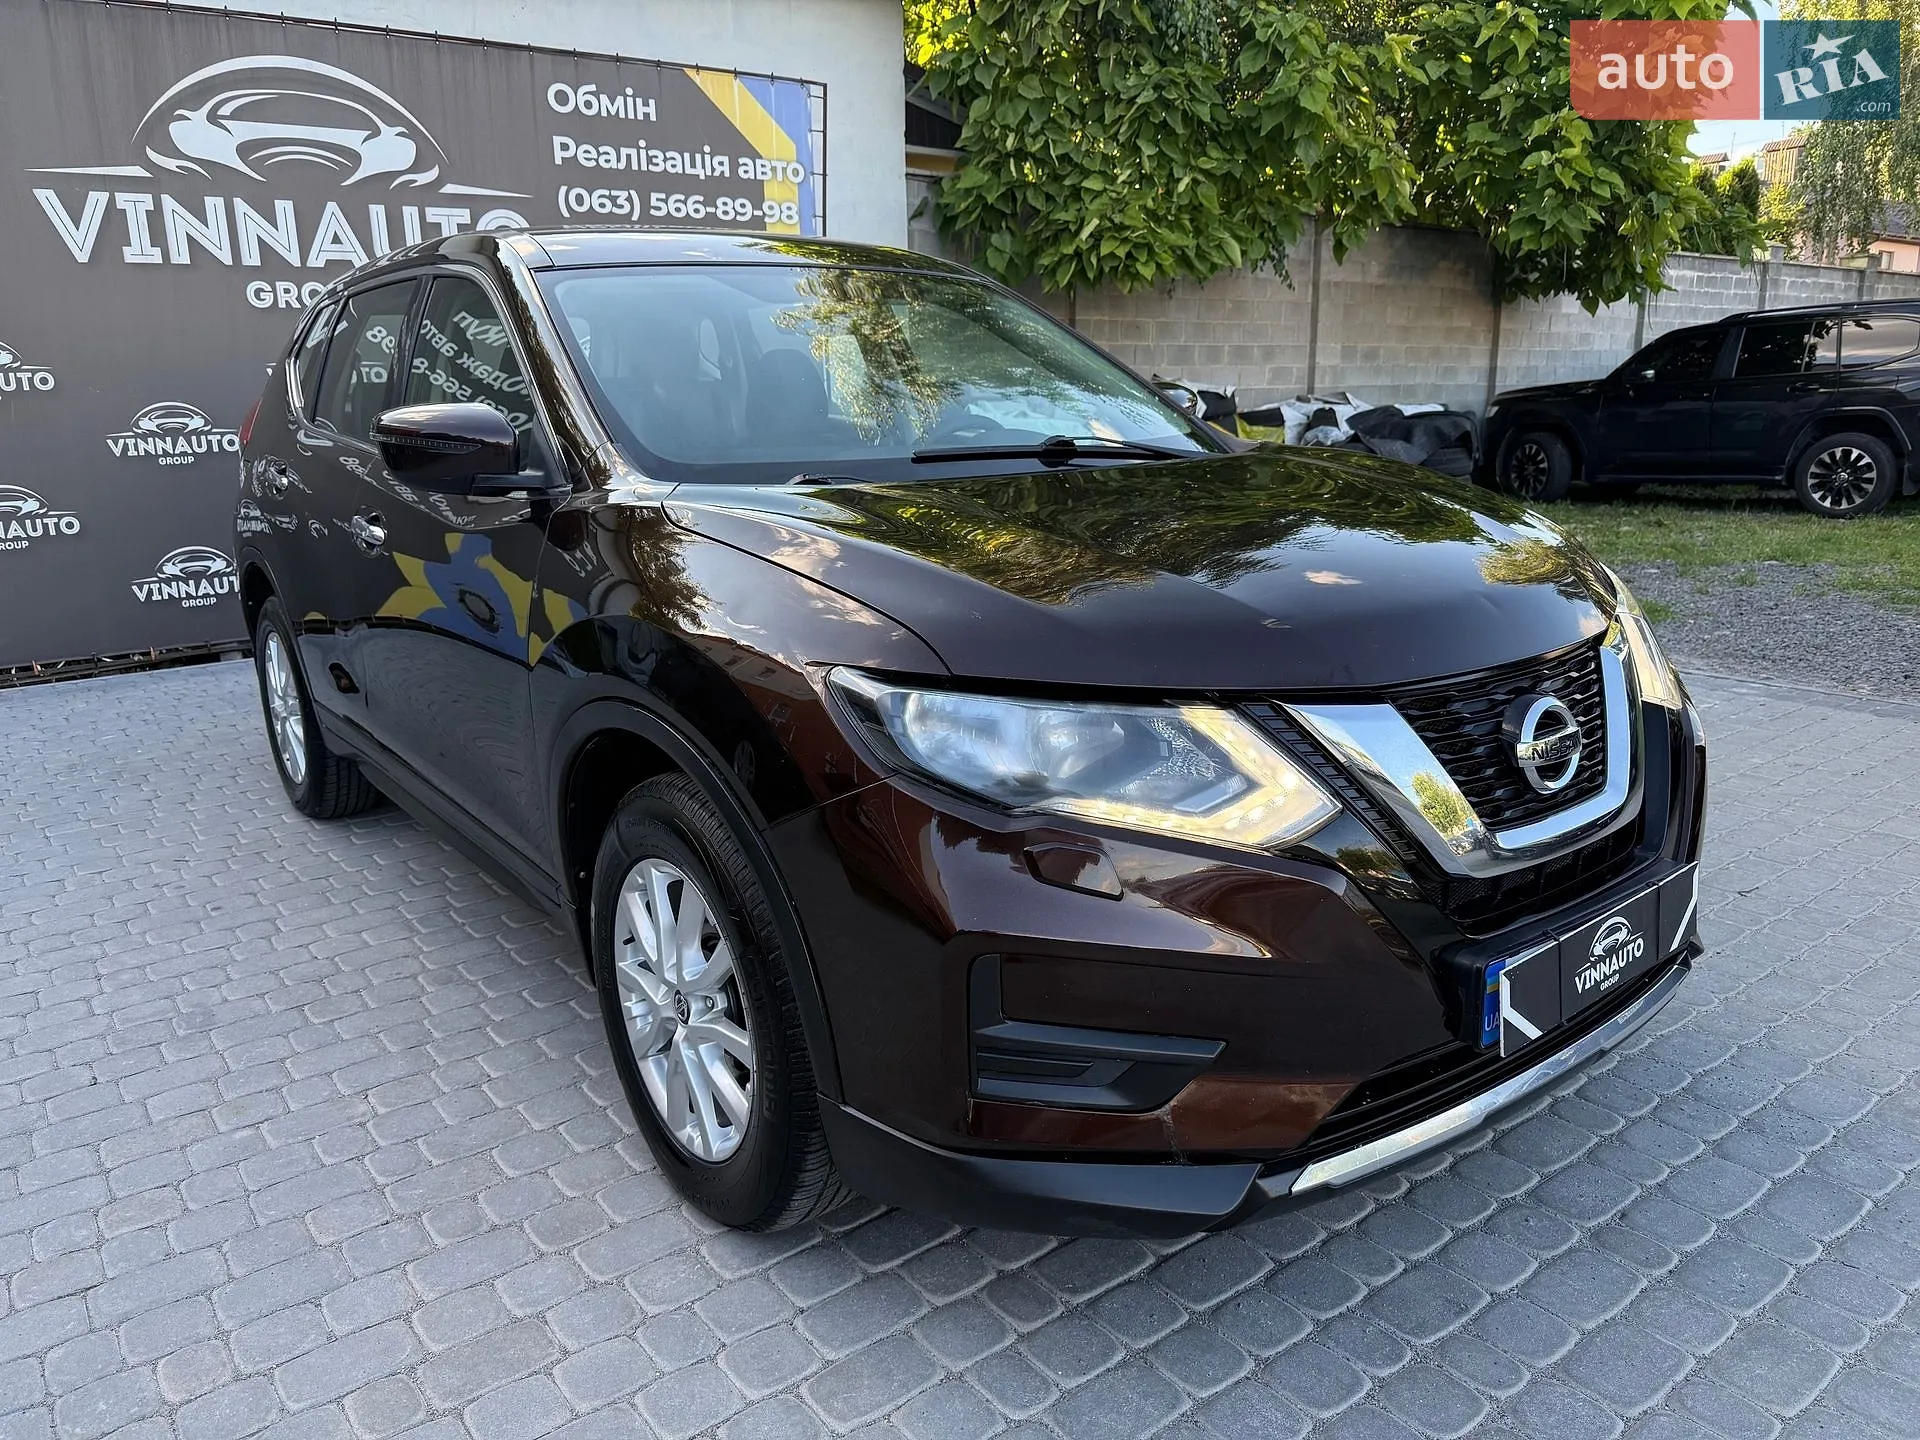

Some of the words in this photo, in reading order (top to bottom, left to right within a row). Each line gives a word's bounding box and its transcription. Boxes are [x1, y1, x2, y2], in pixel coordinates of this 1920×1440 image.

[547, 82, 657, 121] Обмін
[552, 135, 730, 180] Реалізація
[738, 156, 805, 184] авто
[557, 185, 641, 221] (063)
[649, 193, 799, 224] 566-89-98
[246, 281, 326, 309] GRO
[106, 433, 240, 457] VINNAUTO
[158, 455, 195, 466] GROUP
[0, 516, 81, 539] AUTO
[0, 540, 29, 550] ROUP
[131, 575, 240, 603] VINNAUT
[181, 597, 217, 608] GROUP
[1574, 937, 1645, 994] VINNAUTO
[1600, 973, 1620, 991] GROUP
[1484, 1012, 1500, 1032] UA
